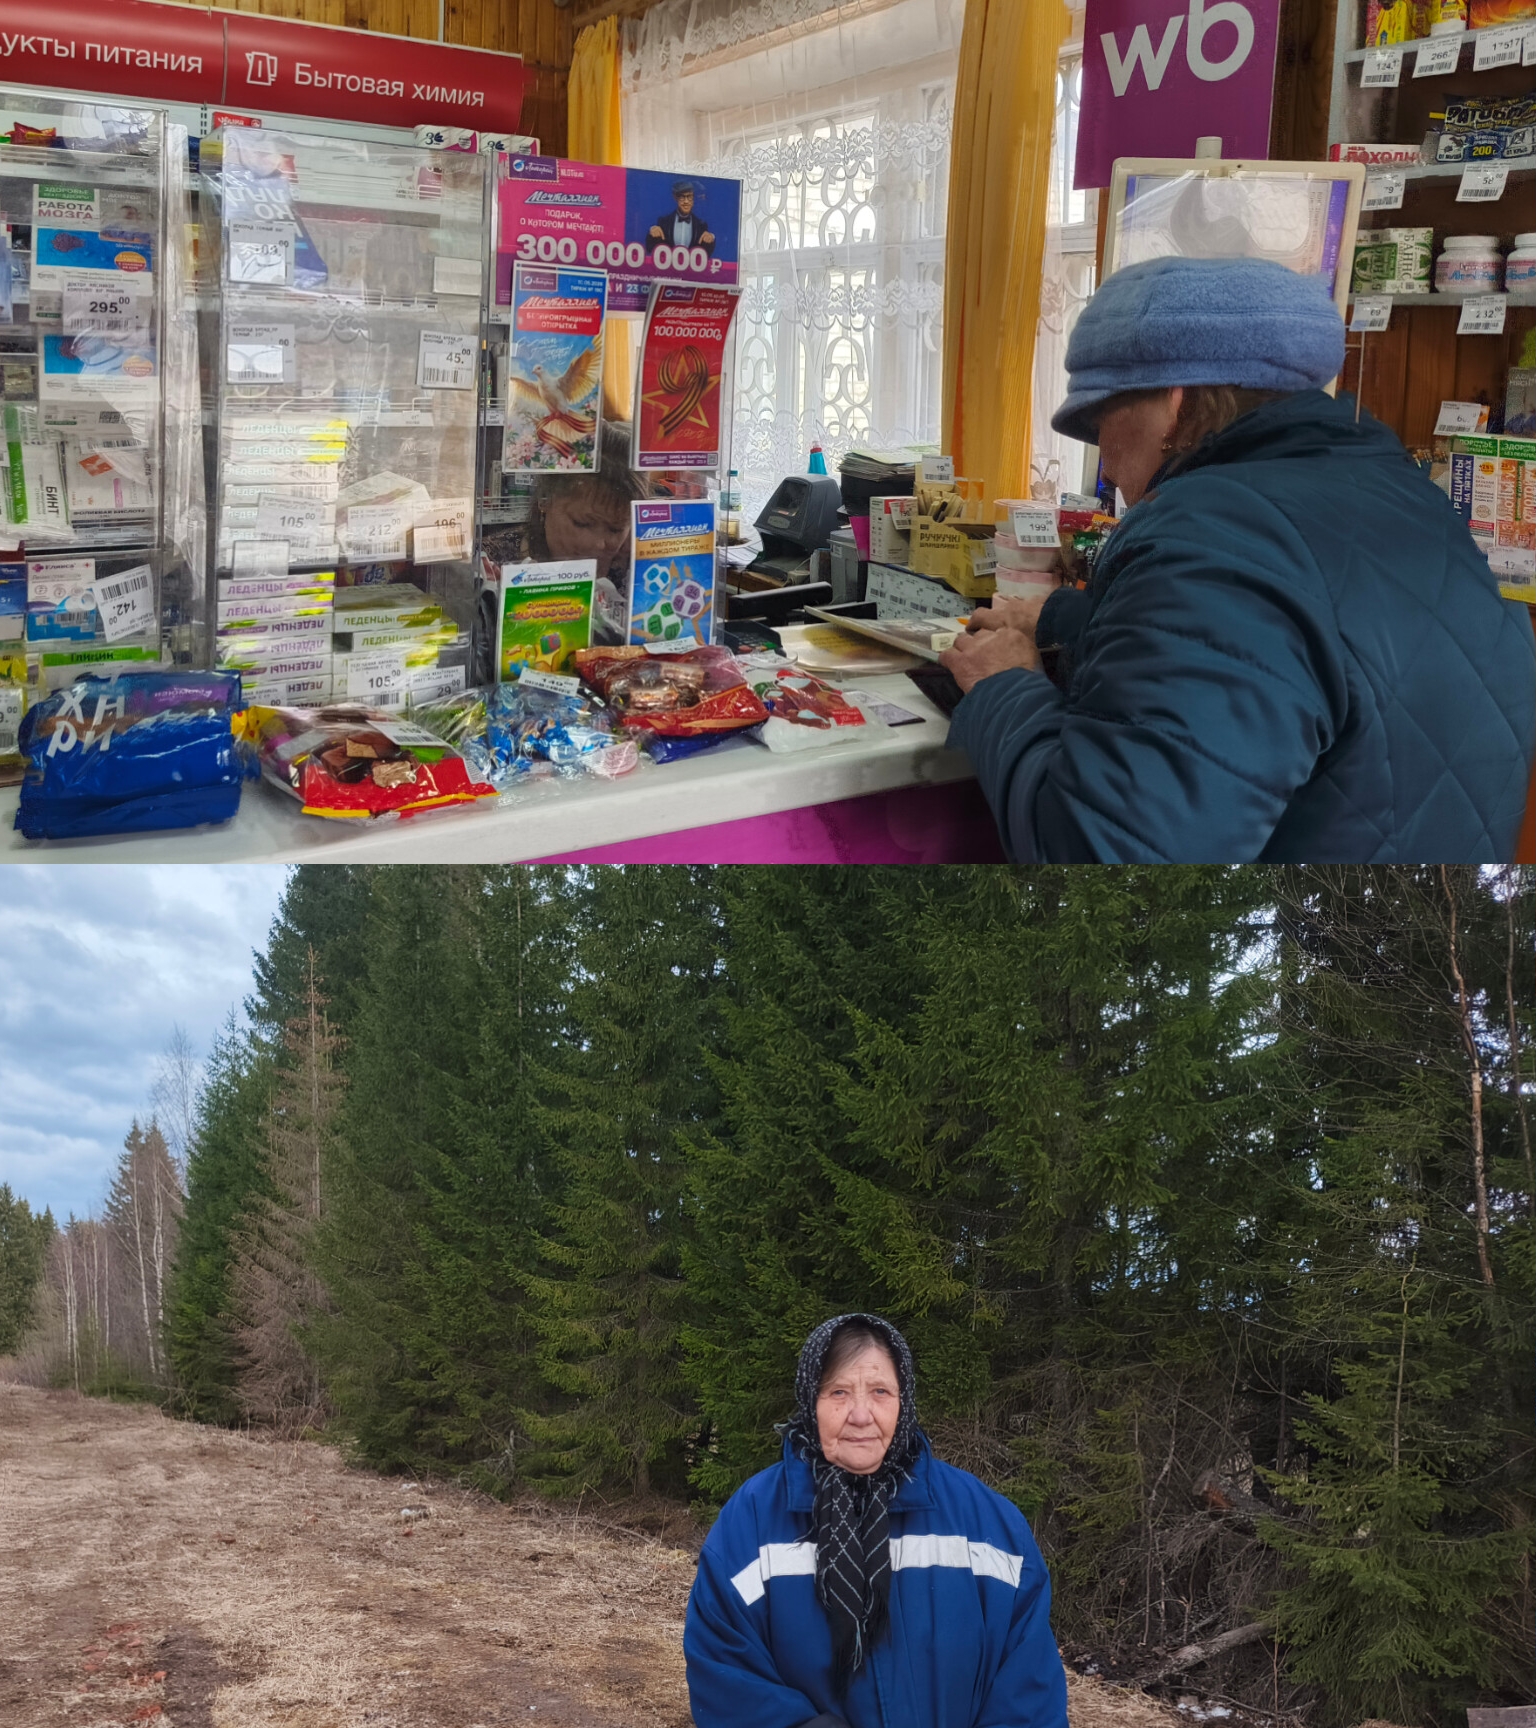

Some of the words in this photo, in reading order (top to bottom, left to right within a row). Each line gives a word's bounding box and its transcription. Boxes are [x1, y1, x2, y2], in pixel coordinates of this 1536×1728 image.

[0, 32, 75, 57] укты
[85, 42, 203, 74] питания
[1100, 0, 1255, 97] wb
[294, 62, 404, 98] Бытовая
[411, 83, 485, 107] химия
[1472, 146, 1492, 156] 200
[37, 208, 93, 219] МОЗГА
[38, 201, 94, 212] РАБОТА
[527, 219, 564, 229] КОТОРОМ
[517, 234, 577, 262] 300
[586, 240, 645, 268] 000
[653, 245, 708, 273] 000
[1453, 459, 1464, 515] РЕЩИНЫ
[46, 486, 59, 515] БИНТ
[227, 583, 283, 595] ЛЕДЕНЦЫ
[226, 604, 282, 617] ЛЕДЕНЦЫ
